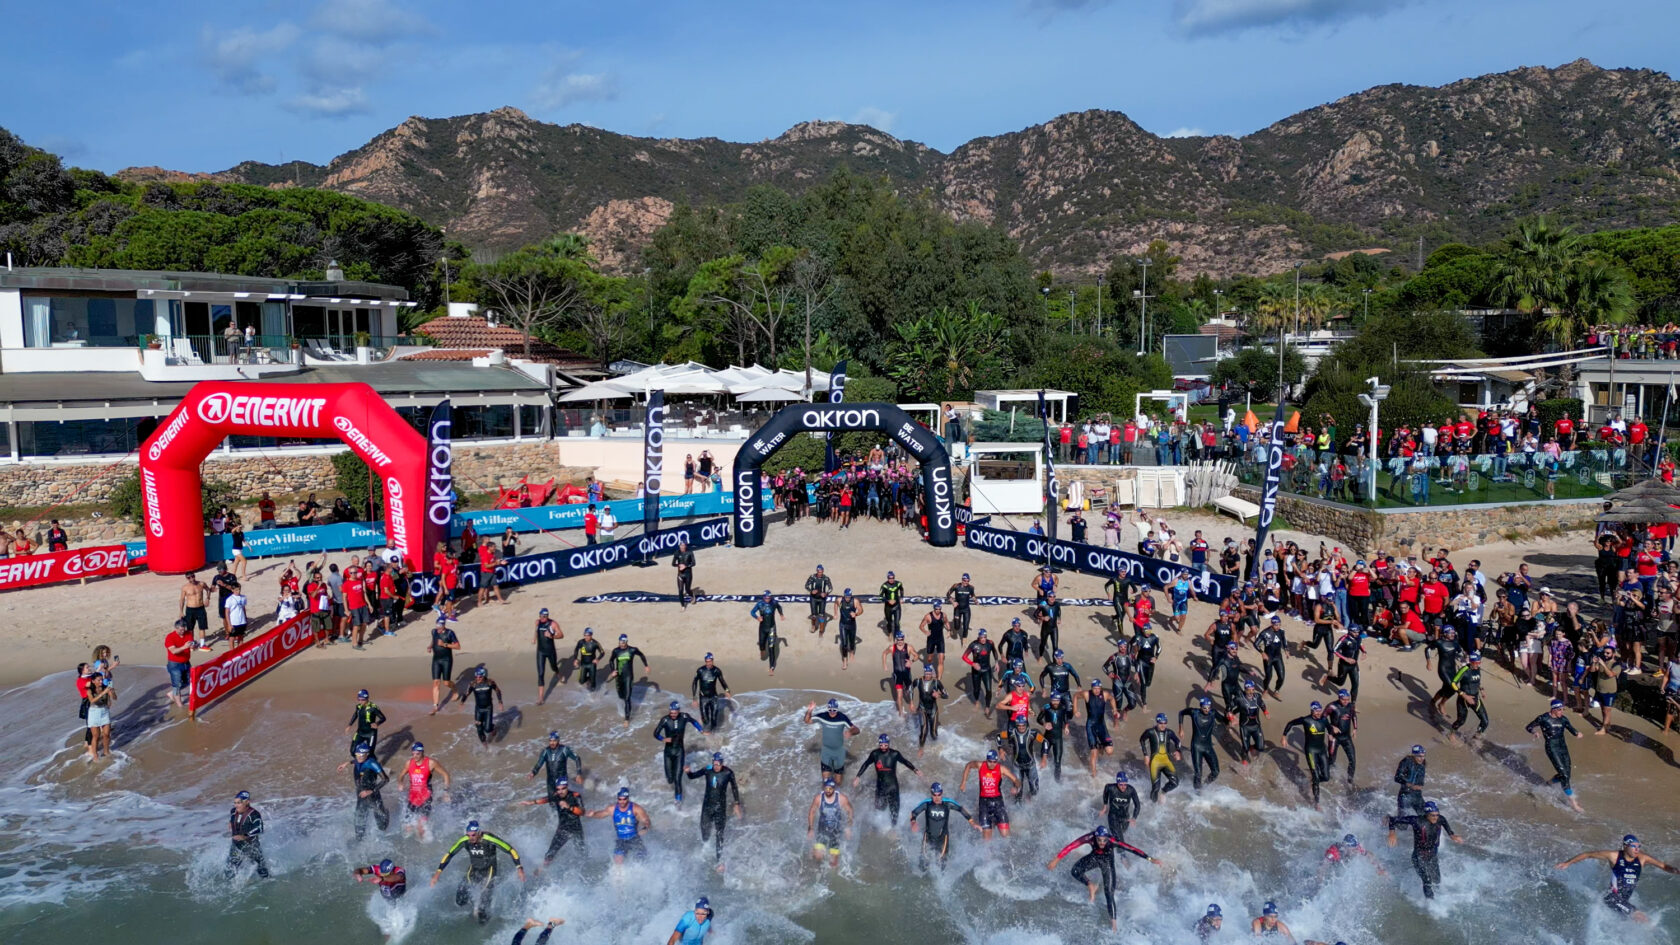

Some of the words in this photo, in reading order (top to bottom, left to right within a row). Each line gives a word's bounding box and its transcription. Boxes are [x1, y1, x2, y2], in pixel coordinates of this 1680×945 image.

[157, 405, 190, 451] ENERVIT
[231, 396, 326, 428] ENERVIT
[803, 409, 880, 428] akron
[902, 422, 914, 433] BE
[345, 427, 392, 467] ENERVIT
[645, 406, 663, 495] akron
[753, 438, 765, 452] BE
[759, 431, 787, 456] WATER
[897, 428, 924, 454] WATER
[429, 421, 451, 526] akron
[1261, 420, 1285, 528] akron
[143, 467, 162, 519] ENERVIT
[739, 471, 754, 533] akron
[931, 465, 952, 530] akron
[389, 496, 409, 556] ENERVIT
[701, 522, 731, 541] akr
[970, 529, 1017, 552] akron
[496, 557, 557, 584] akron
[570, 544, 628, 570] akron
